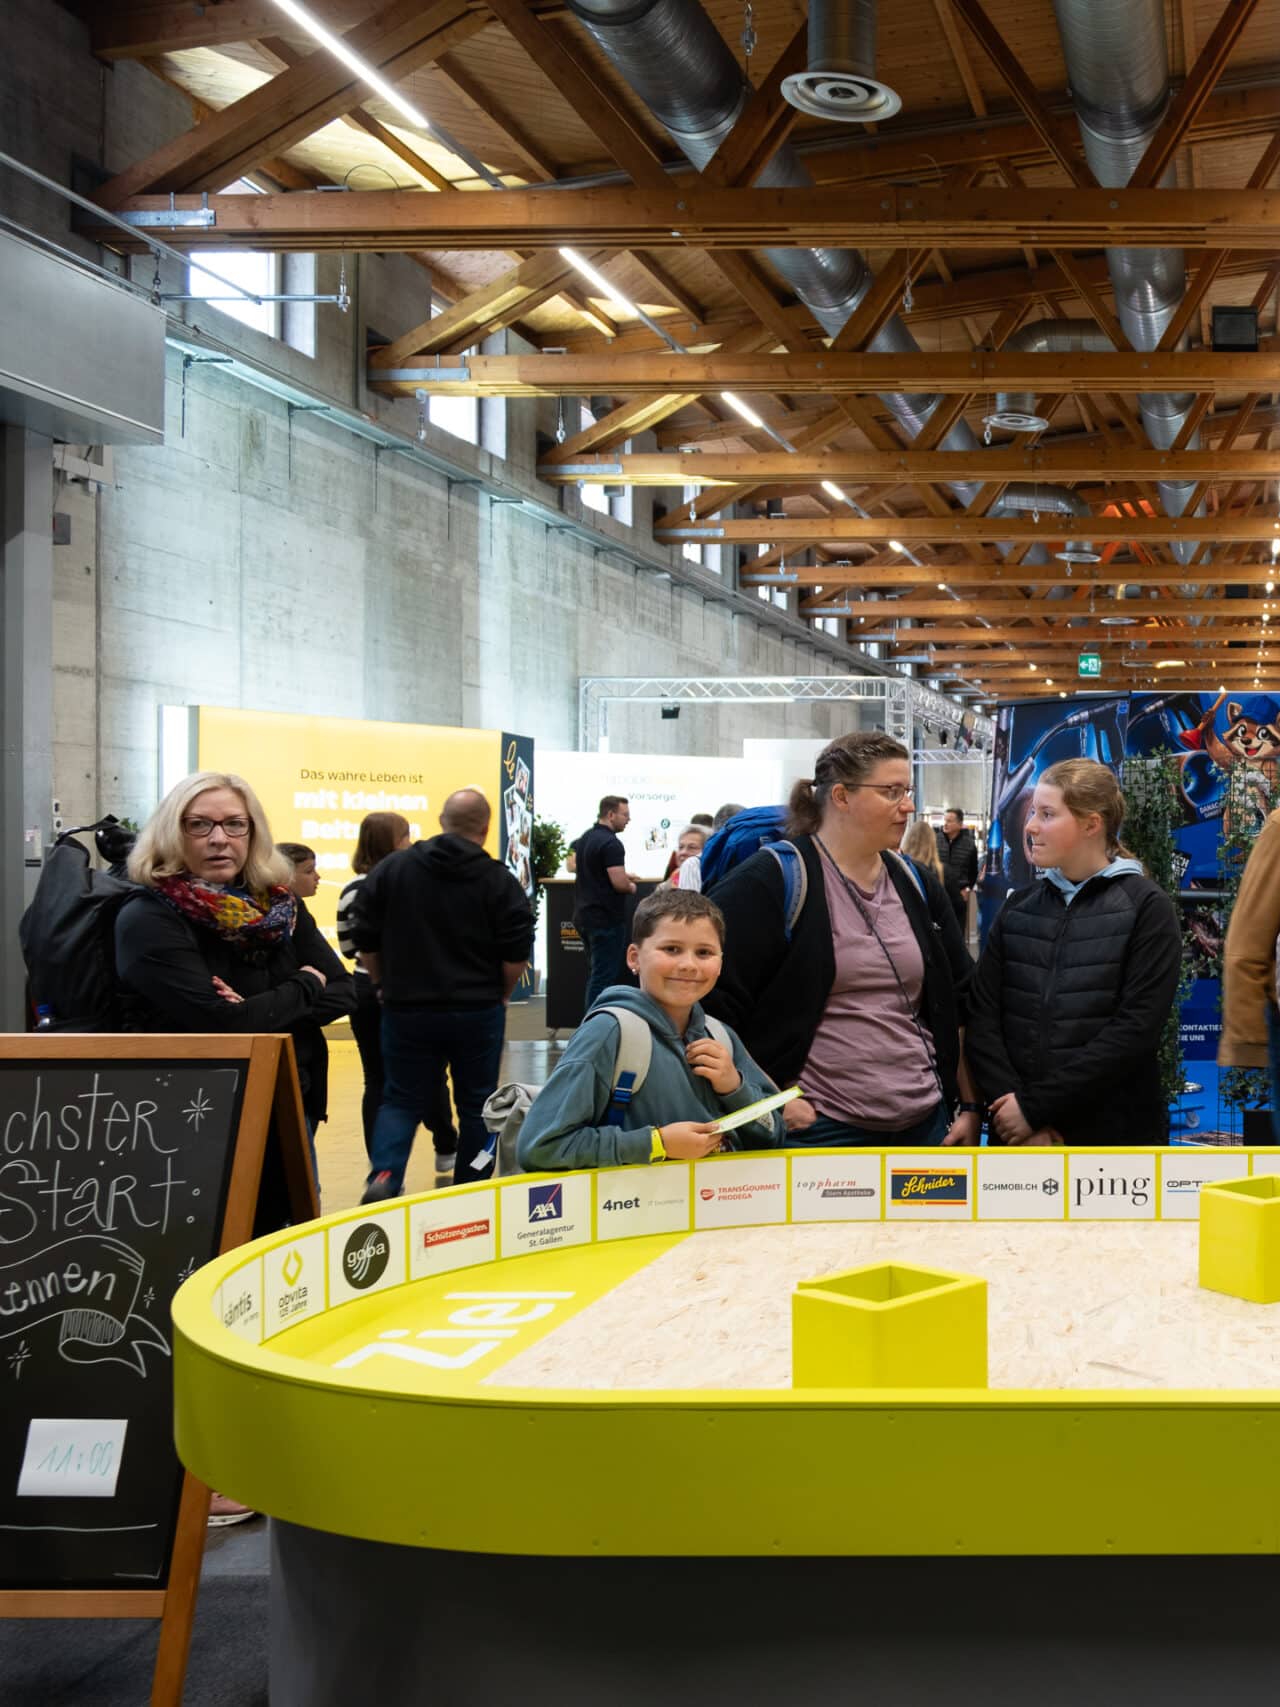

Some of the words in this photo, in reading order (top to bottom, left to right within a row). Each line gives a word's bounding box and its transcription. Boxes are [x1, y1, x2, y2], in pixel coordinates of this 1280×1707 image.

[300, 769, 324, 780] Das
[328, 770, 367, 782] wahre
[370, 772, 406, 783] Leben
[409, 773, 423, 784] ist
[293, 788, 338, 809] mit
[342, 790, 428, 811] kleinen
[901, 1175, 956, 1198] Schnider
[982, 1183, 1038, 1191] SCHMOBI.CH
[1075, 1168, 1151, 1207] ping
[529, 1202, 557, 1220] AXA
[602, 1197, 640, 1211] 4net
[517, 1224, 575, 1240] Generalagentur
[529, 1238, 539, 1247] St.
[540, 1235, 563, 1246] Gallen
[279, 1286, 308, 1308] obvita
[333, 1291, 575, 1369] Ziel
[36, 1441, 114, 1477] 11:00
